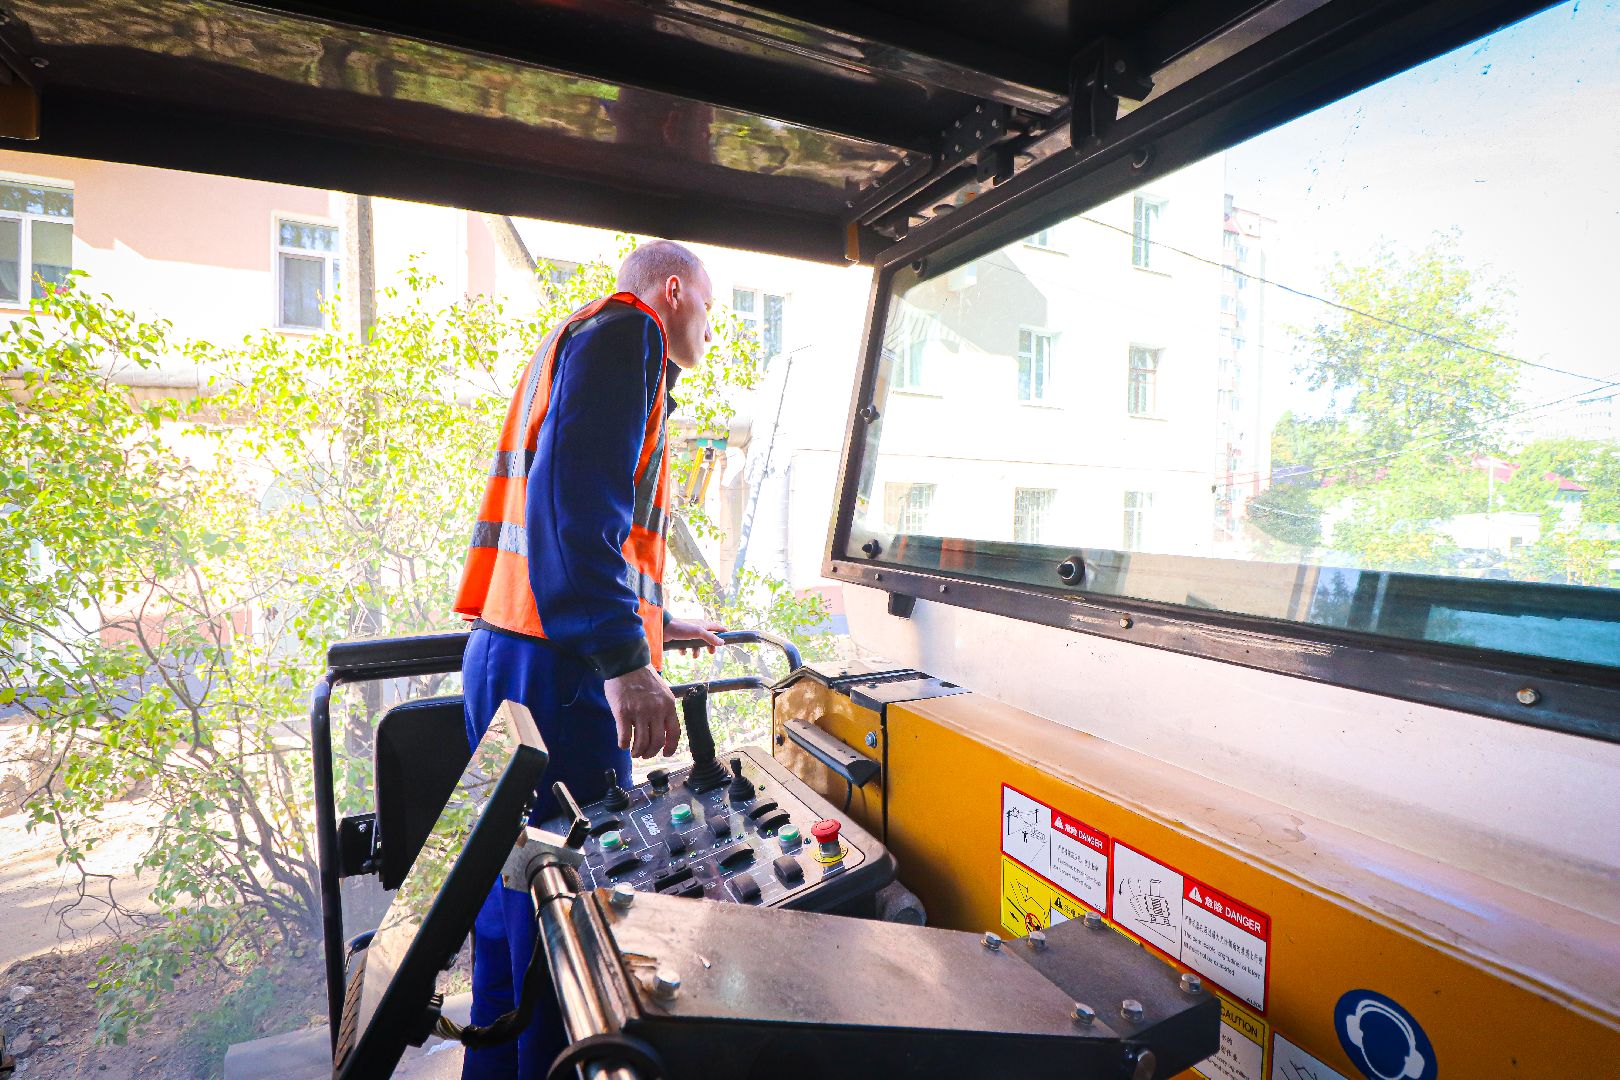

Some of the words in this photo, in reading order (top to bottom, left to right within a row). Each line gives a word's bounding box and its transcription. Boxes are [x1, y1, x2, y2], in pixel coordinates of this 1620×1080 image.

[1079, 830, 1103, 850] DANGER
[1225, 907, 1261, 934] DANGER
[1221, 1006, 1258, 1038] CAUTION
